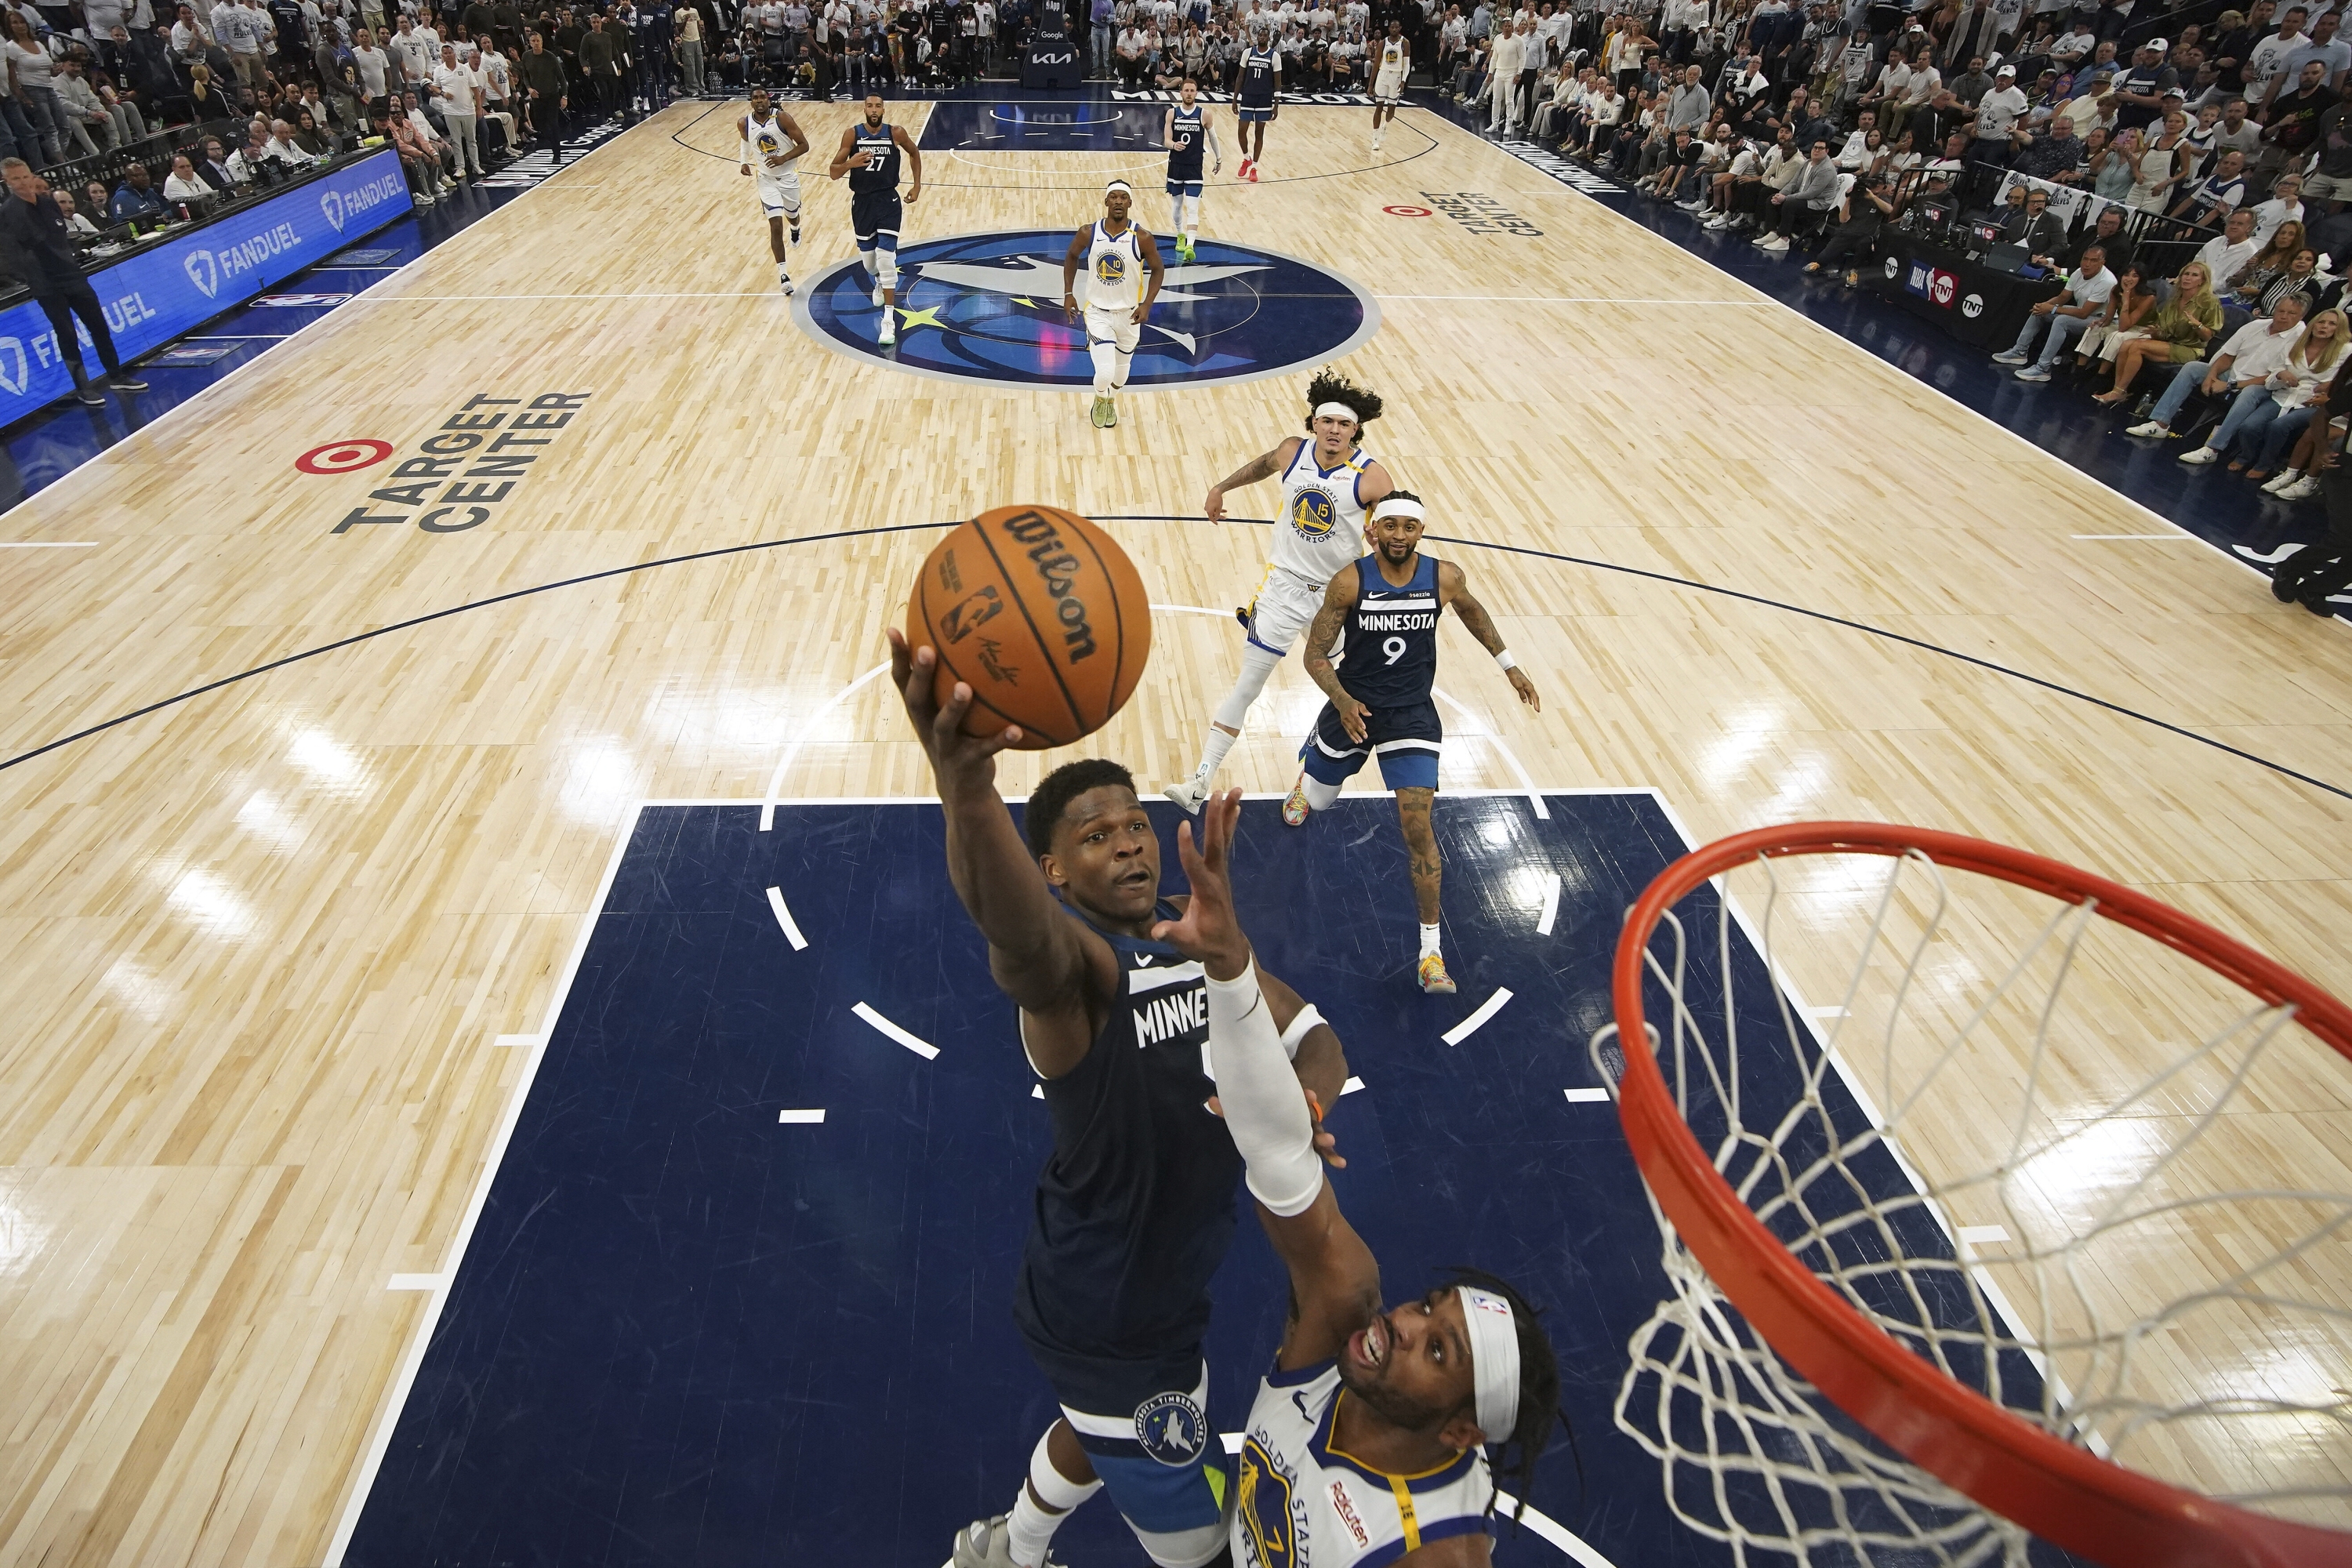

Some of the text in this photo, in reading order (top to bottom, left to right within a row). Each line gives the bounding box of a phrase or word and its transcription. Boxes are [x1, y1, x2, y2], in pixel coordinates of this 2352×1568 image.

[1051, 2, 1060, 12] App
[1041, 31, 1064, 39] Google
[410, 47, 417, 56] 3
[1254, 67, 1261, 78] 11
[1174, 124, 1200, 132] MINNESOTA
[1181, 132, 1191, 145] 0
[485, 149, 590, 180] PLAYOFFS
[865, 156, 886, 172] 27
[1491, 140, 1628, 194] TIMBERWOLVES
[344, 172, 405, 218] FANDUEL
[1418, 191, 1504, 235] TARGET
[1456, 191, 1544, 237] CENTER
[217, 221, 302, 279] FANDUEL
[1096, 249, 1126, 260] GOLDEN STATE
[1113, 260, 1121, 269] 10
[1885, 262, 1898, 275] TNT
[1096, 274, 1126, 287] WARRIORS
[1909, 266, 1953, 299] NBA TNT
[1962, 299, 1984, 314] TNT
[329, 393, 523, 534] TARGET
[418, 392, 593, 533] CENTER
[1294, 483, 1339, 504] GOLDEN STATE
[1317, 503, 1329, 518] 15
[1290, 520, 1337, 544] WARRIORS
[1003, 510, 1096, 665] Wilson
[1358, 613, 1435, 632] MINNESOTA
[1382, 636, 1407, 666] 9
[1133, 986, 1210, 1049] MINNE
[1138, 1395, 1205, 1446] MINNESOTA TIMBERWOLVES
[1330, 1480, 1370, 1549] Rakuten
[1267, 1525, 1285, 1553] 7
